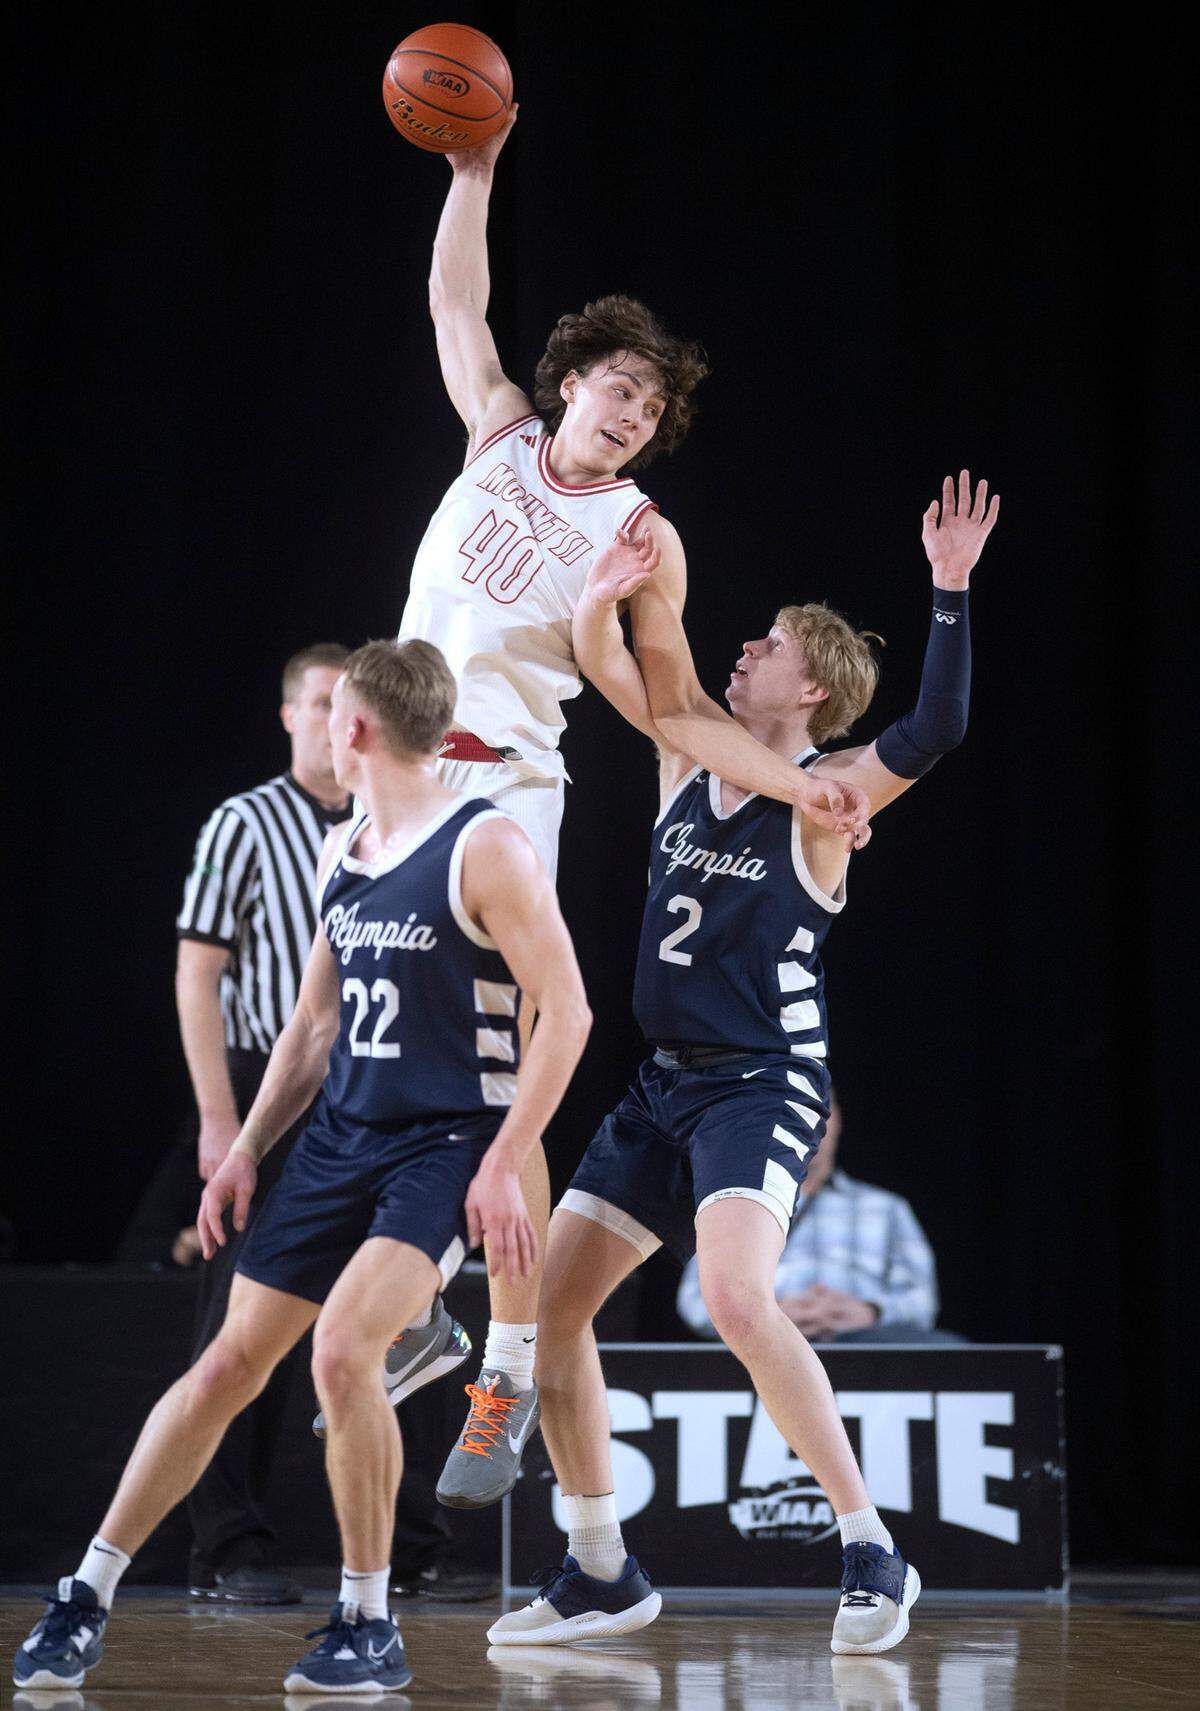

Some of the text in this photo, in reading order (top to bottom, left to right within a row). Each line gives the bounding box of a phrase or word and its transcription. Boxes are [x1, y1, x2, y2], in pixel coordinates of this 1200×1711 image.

[458, 509, 544, 604] 40
[547, 531, 594, 567] SI
[659, 821, 767, 883] Olympia
[324, 901, 437, 966] Olympia
[658, 893, 703, 967] 2
[341, 977, 402, 1059] 22
[749, 1500, 834, 1526] WIAA
